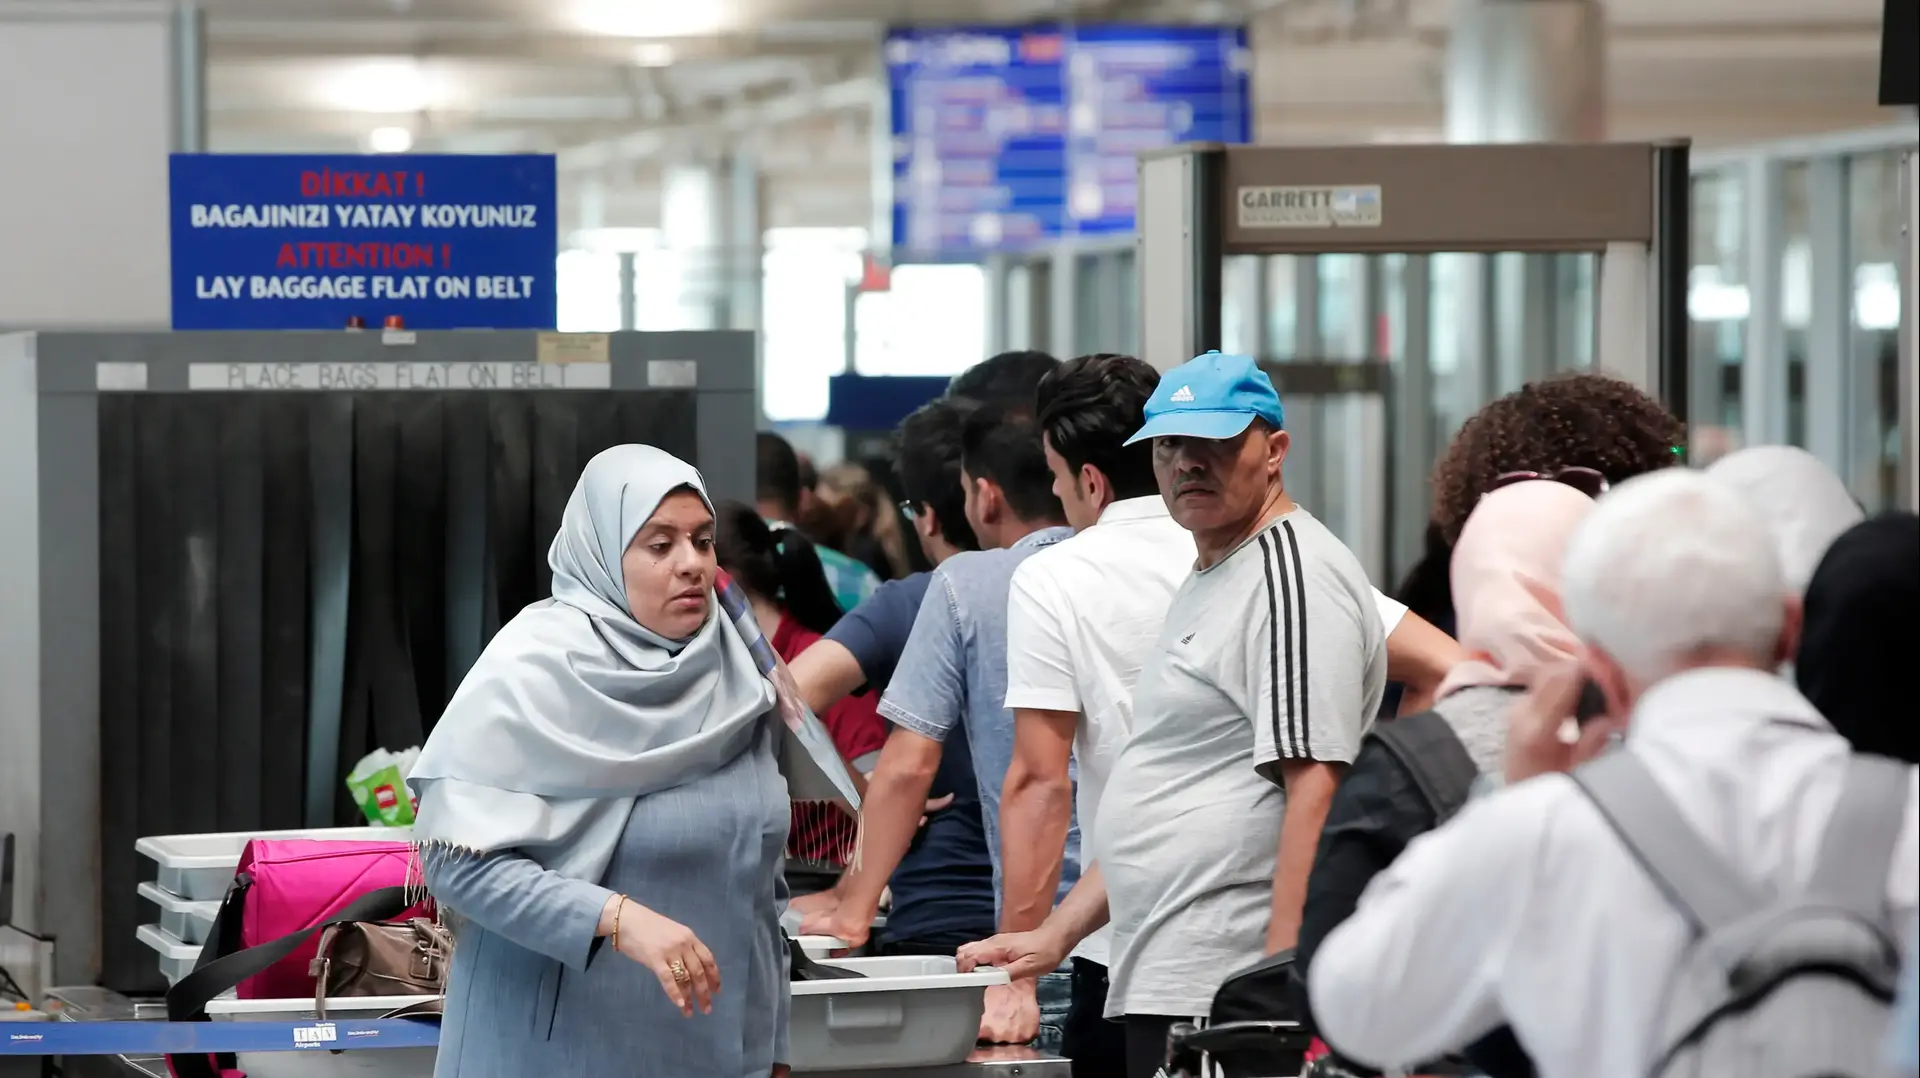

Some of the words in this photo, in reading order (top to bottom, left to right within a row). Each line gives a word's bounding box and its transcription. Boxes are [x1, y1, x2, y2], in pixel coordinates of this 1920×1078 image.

[301, 167, 407, 197] DİKKAT
[416, 172, 424, 197] !
[1242, 191, 1333, 208] GARRETT
[190, 204, 329, 228] BAGAJINIZI
[335, 204, 416, 228] YATAY
[421, 204, 537, 228] KOYUNUZ
[277, 242, 433, 269] ATTENTION
[442, 243, 450, 269] !
[196, 275, 245, 299] LAY
[250, 275, 367, 299] BAGGAGE
[371, 275, 430, 299] FLAT
[434, 275, 470, 299] ON
[475, 275, 534, 299] BELT
[227, 363, 301, 389] PLACE
[318, 363, 379, 389] BAGS
[395, 363, 453, 389] FLAT
[467, 364, 497, 388] ON
[511, 362, 570, 388] BELT
[296, 1028, 334, 1041] TAV
